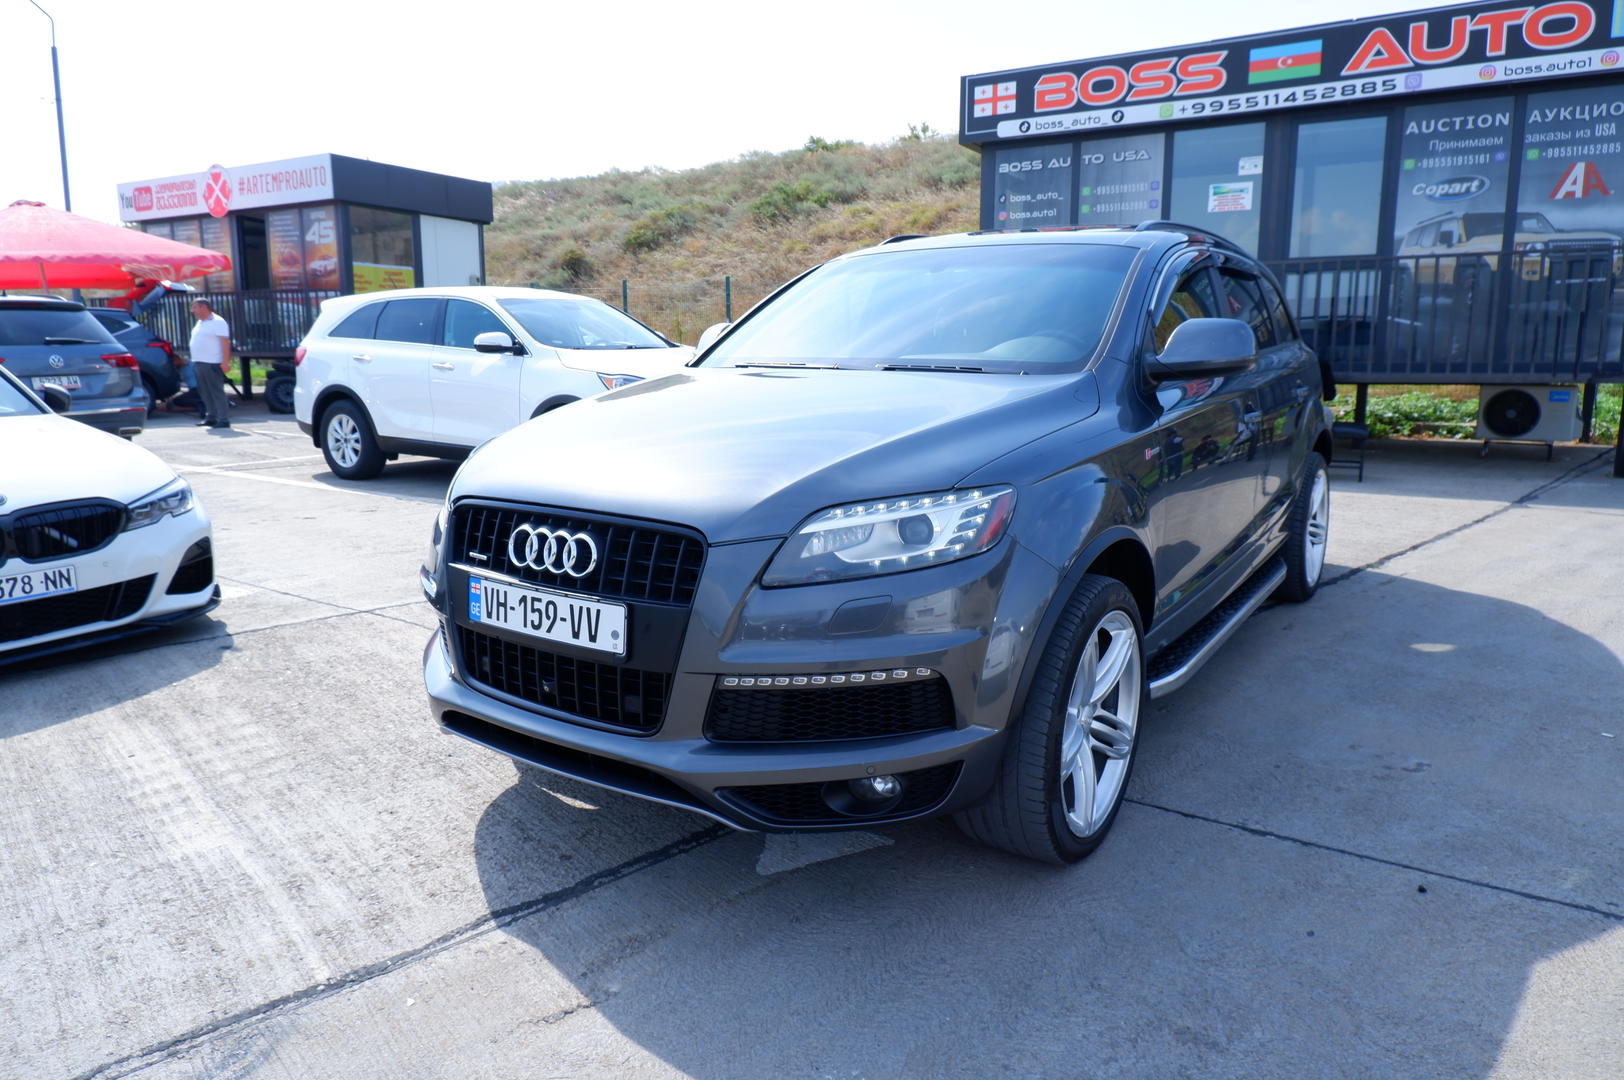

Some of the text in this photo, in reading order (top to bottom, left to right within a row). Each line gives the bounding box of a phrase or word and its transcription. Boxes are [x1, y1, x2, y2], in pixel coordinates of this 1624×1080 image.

[1034, 1, 1596, 113] BOSS AUTO
[1504, 57, 1592, 77] boss.auto1
[1179, 79, 1397, 115] +995511452885
[1035, 114, 1109, 131] boss_auto_
[1528, 101, 1624, 123] АУКЦИО
[1405, 112, 1509, 135] AUCTION
[1525, 122, 1616, 143] заказы из USA
[1429, 136, 1504, 152] Принимаем
[999, 159, 1043, 173] BOSS
[1113, 150, 1151, 162] USA
[238, 166, 327, 195] #ARTEMPROAUTO
[1412, 178, 1481, 197] Copart
[305, 221, 335, 245] 45
[470, 601, 481, 617] GE
[484, 586, 601, 643] VH-159-VV
